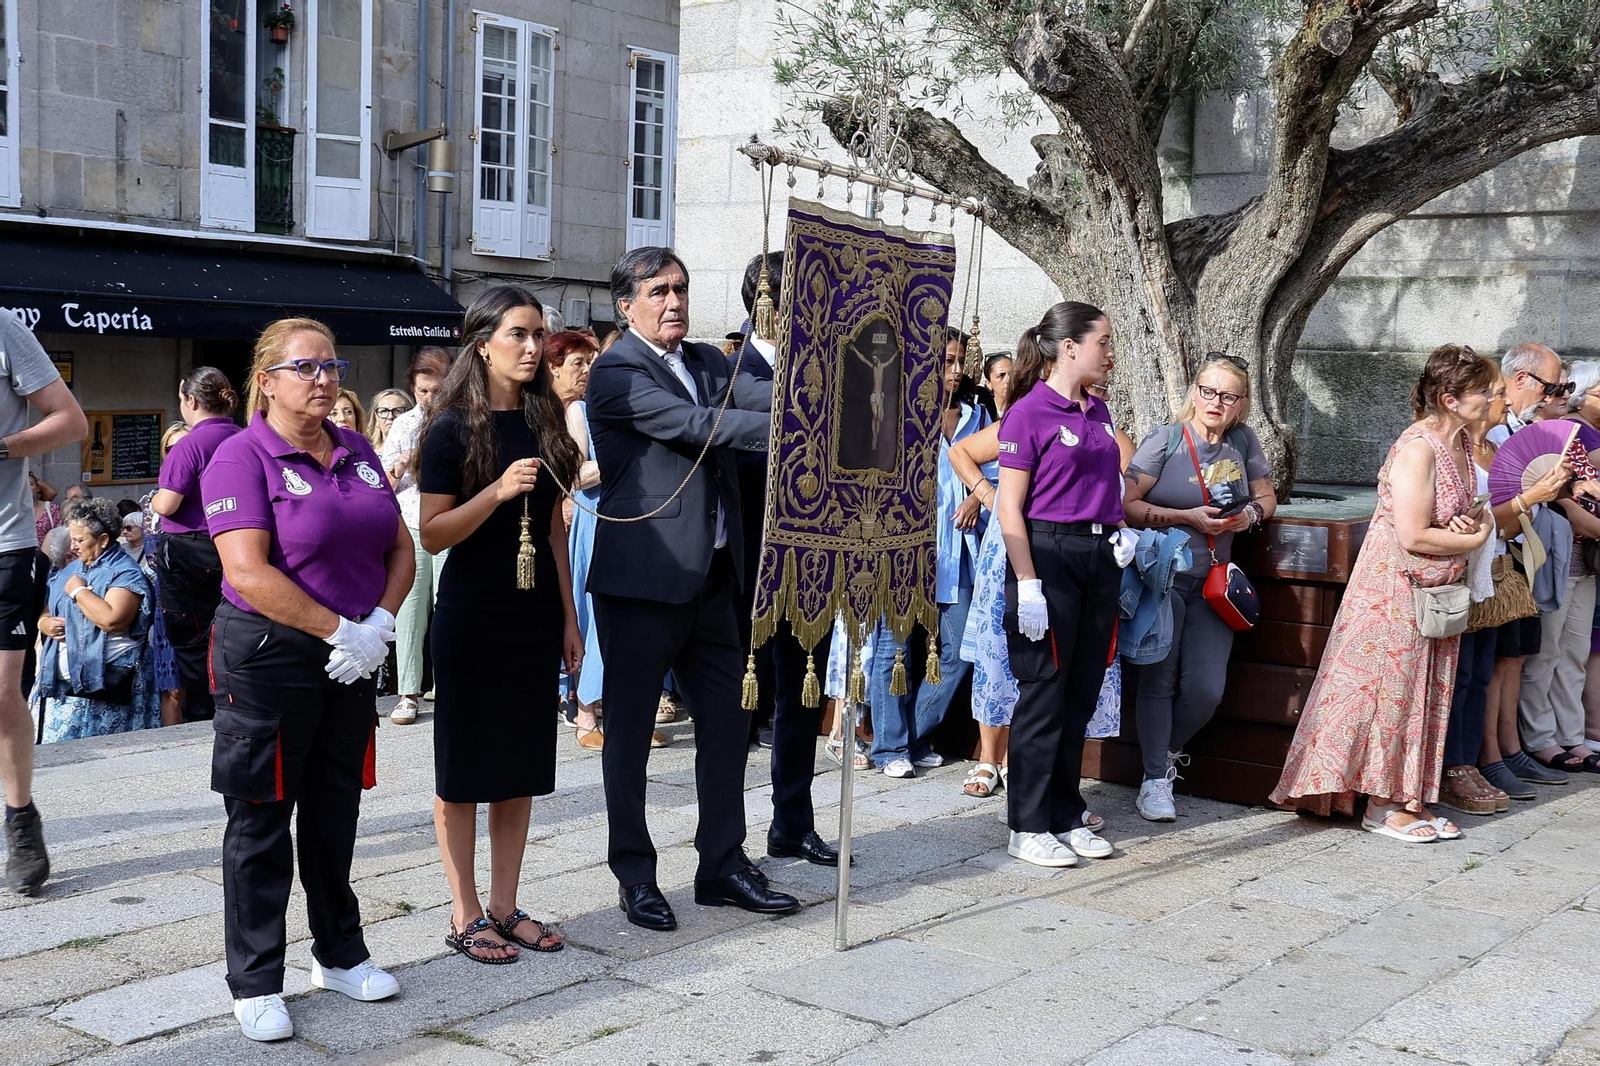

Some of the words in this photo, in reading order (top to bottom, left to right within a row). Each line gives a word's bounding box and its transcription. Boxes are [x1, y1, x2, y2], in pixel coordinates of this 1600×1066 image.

[61, 303, 153, 334] Tapería
[389, 325, 423, 337] Estrella
[423, 326, 451, 338] Galicia
